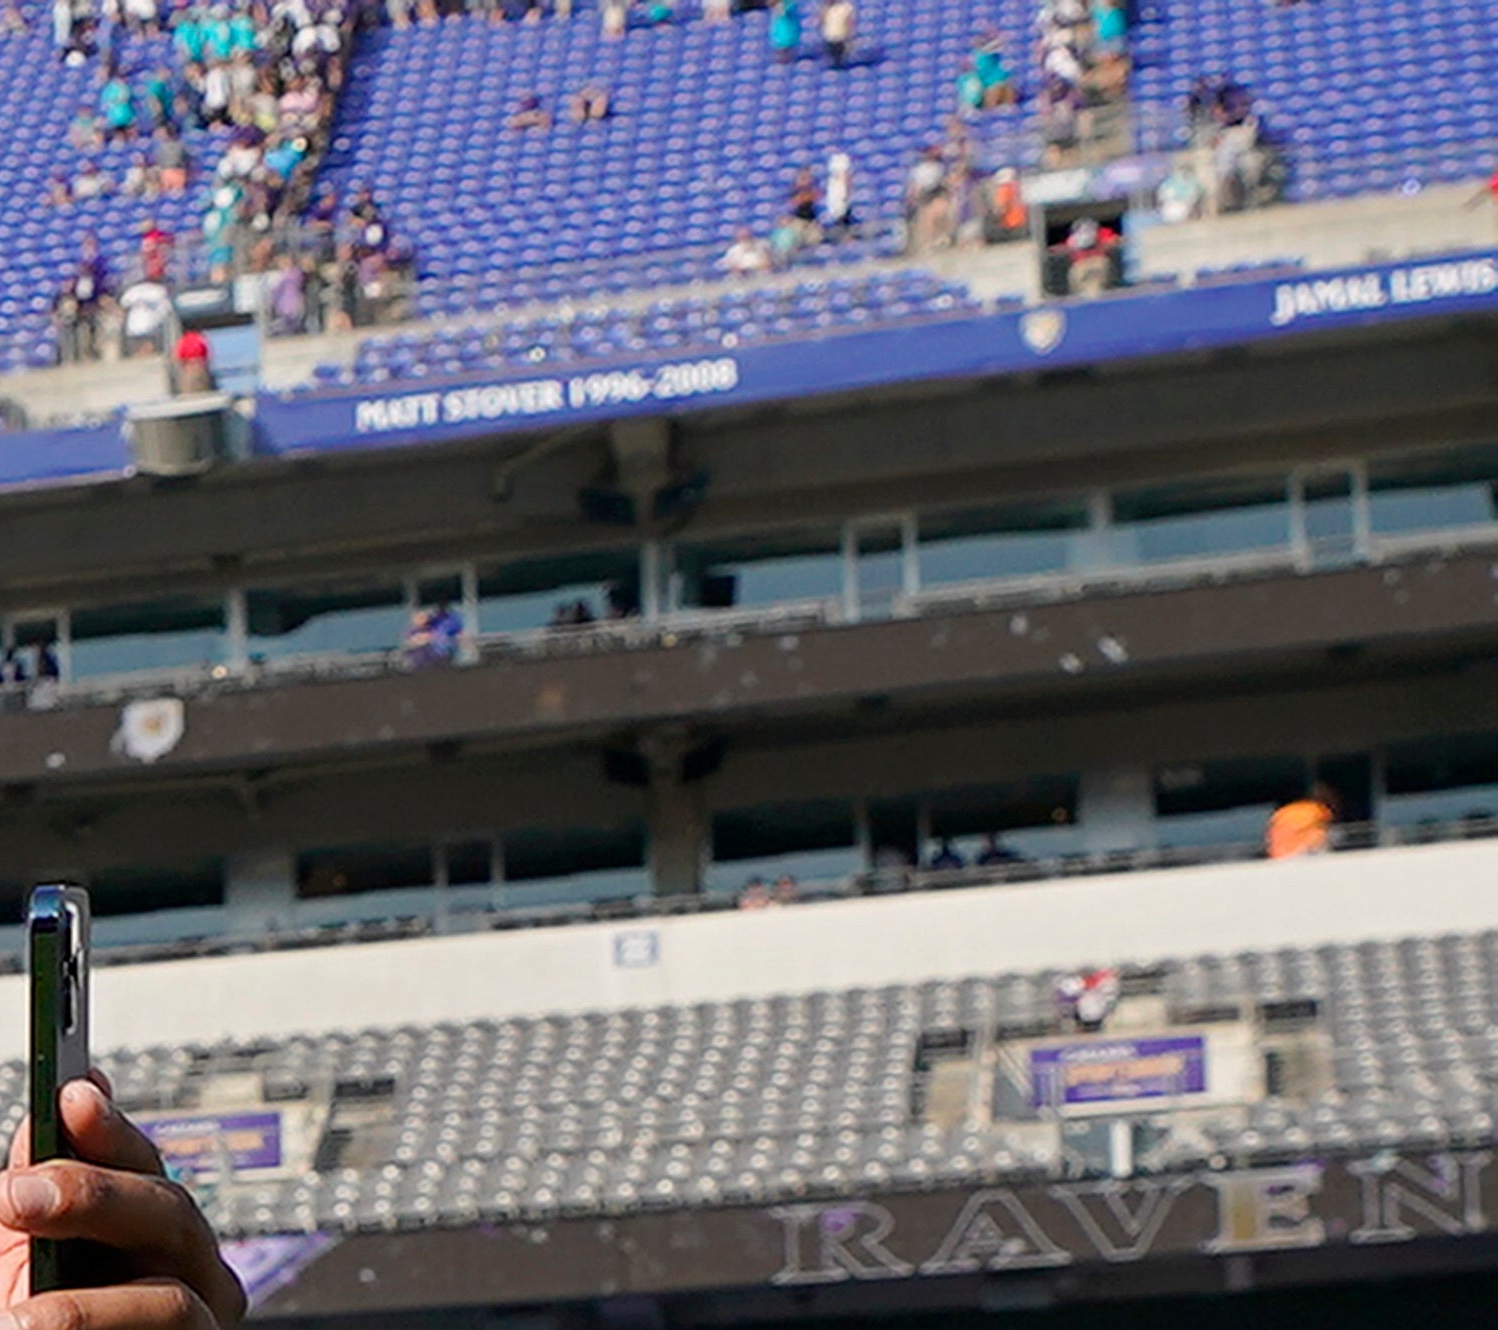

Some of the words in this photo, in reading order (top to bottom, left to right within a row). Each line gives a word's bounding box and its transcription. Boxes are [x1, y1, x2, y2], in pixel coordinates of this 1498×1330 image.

[1269, 272, 1388, 326] JAMAL
[355, 392, 440, 432] MATT
[444, 379, 563, 422] STOVER
[568, 357, 738, 407] 1996-2008
